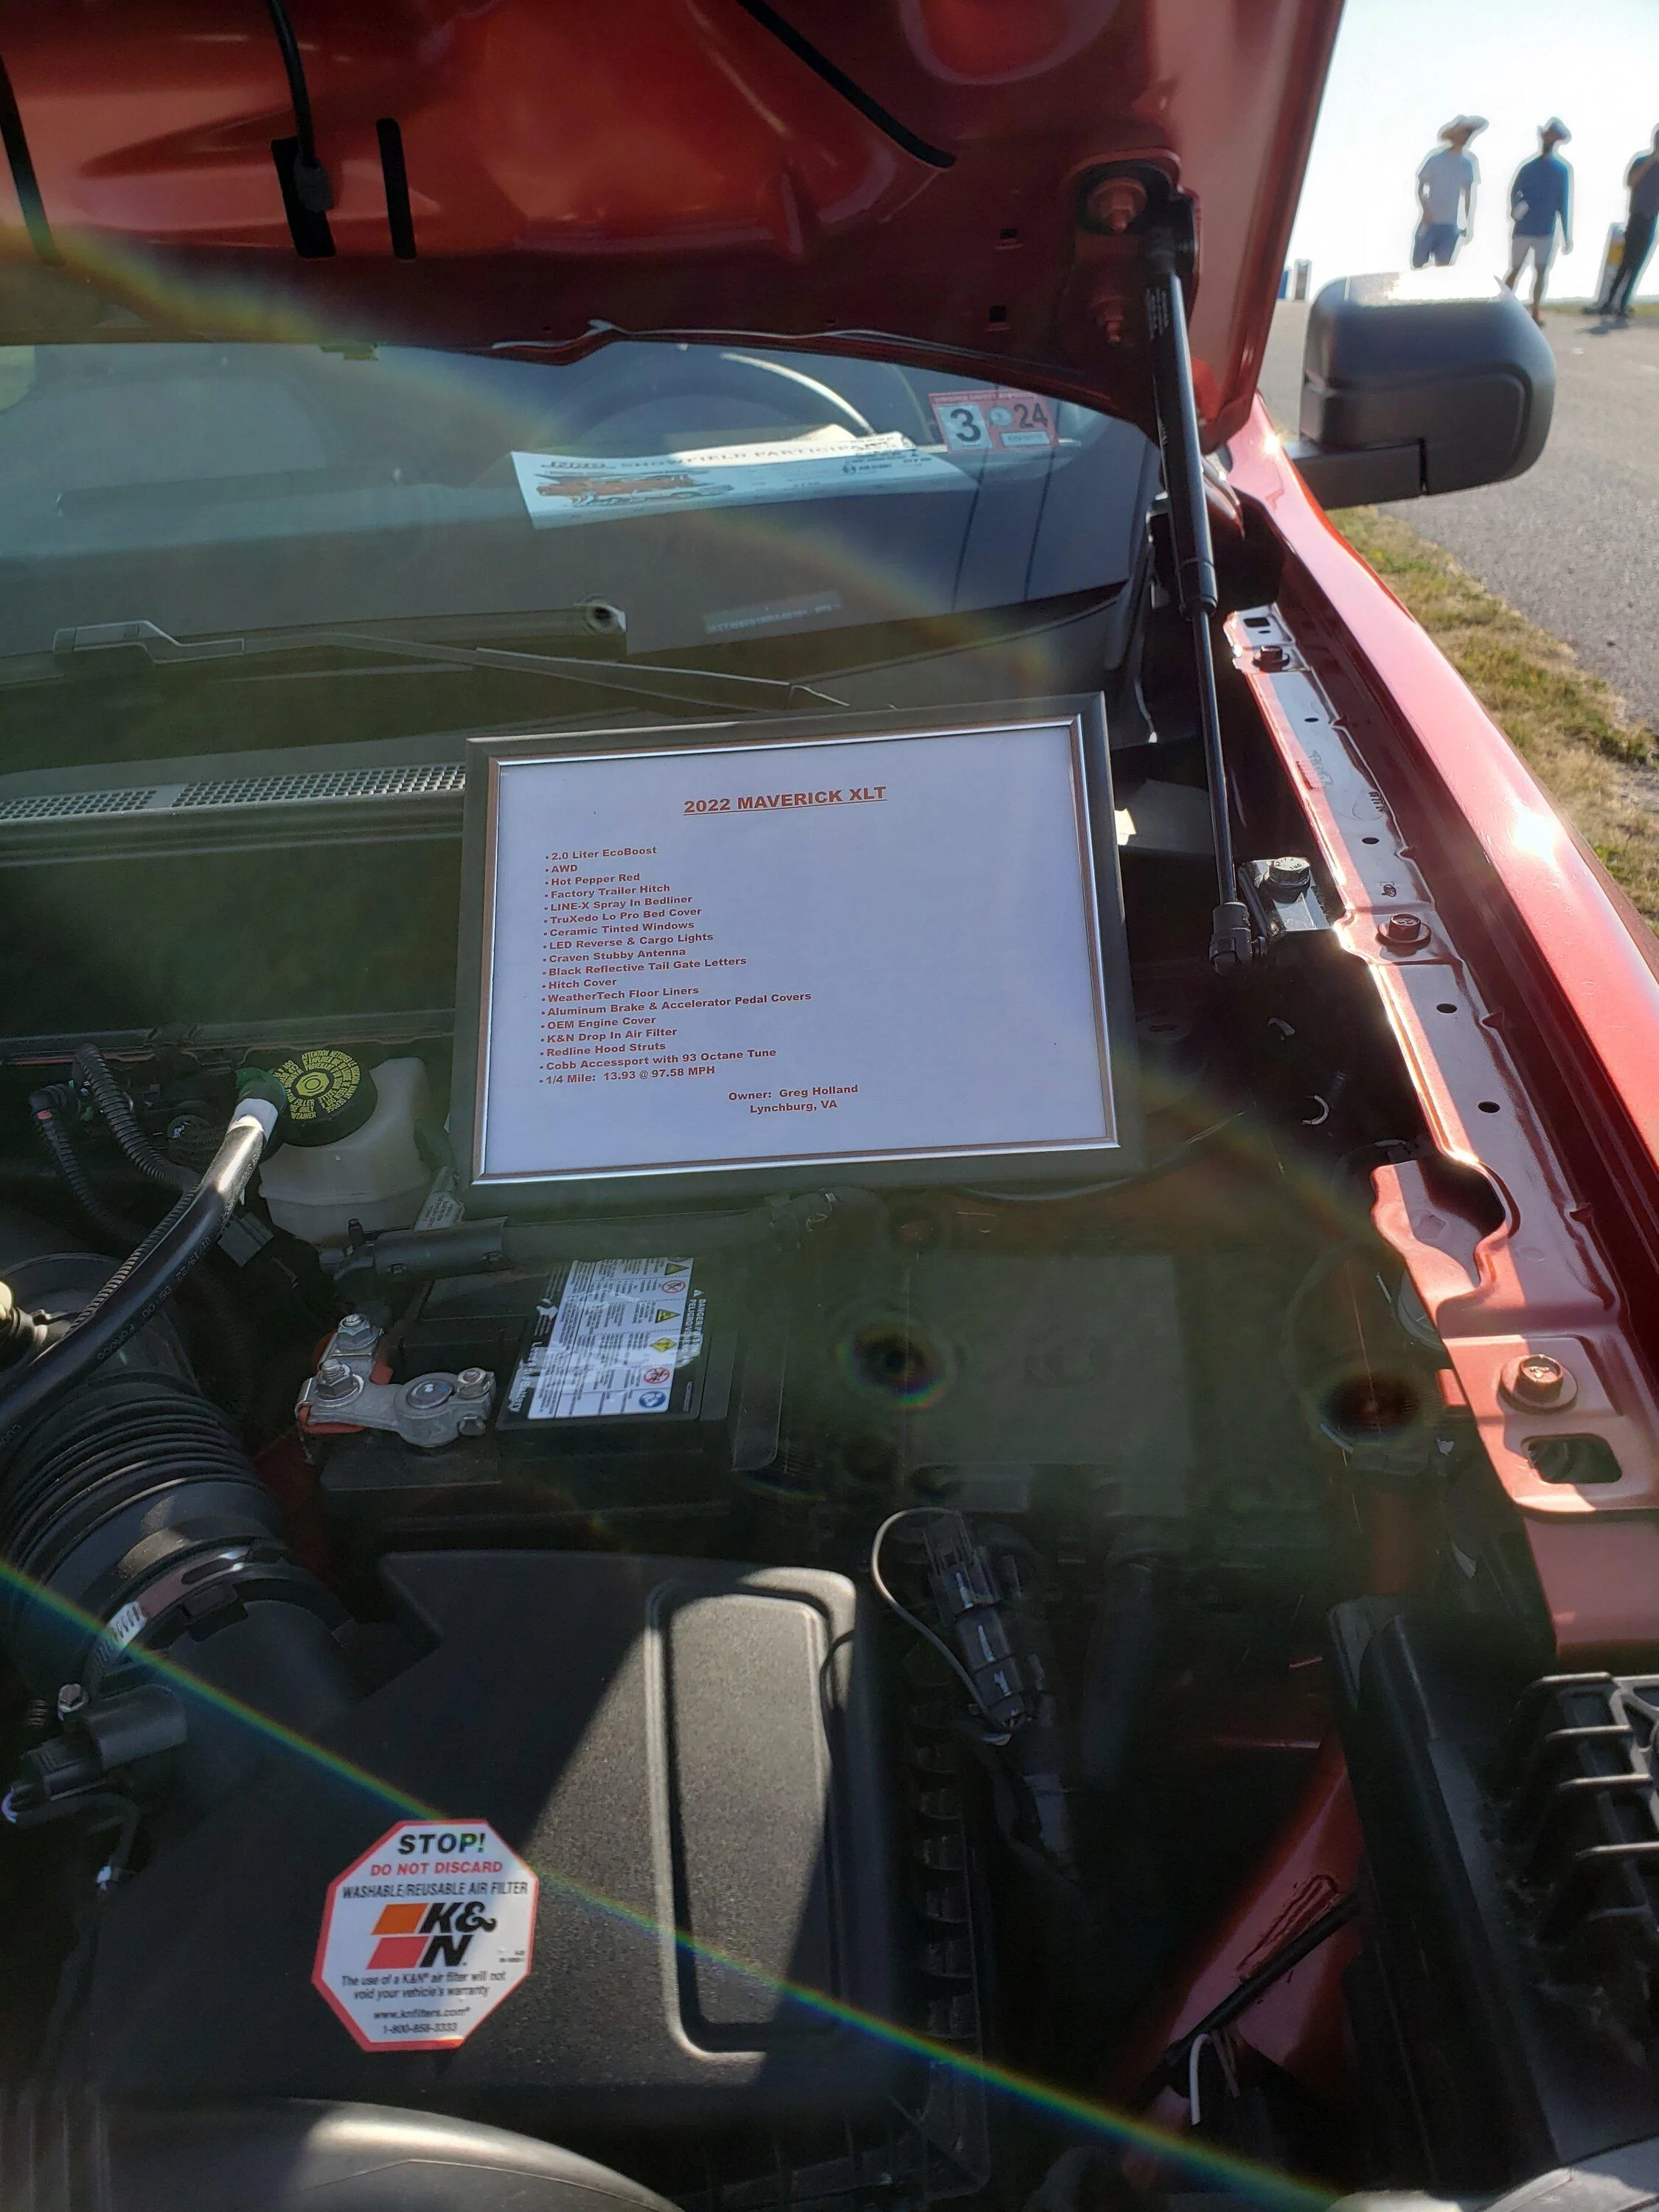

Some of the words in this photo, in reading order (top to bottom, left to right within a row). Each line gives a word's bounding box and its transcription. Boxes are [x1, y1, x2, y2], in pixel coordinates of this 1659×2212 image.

[1014, 403, 1048, 428] 24
[950, 408, 981, 442] 3
[684, 798, 731, 813] 2022
[737, 789, 844, 810] MAVERICK
[849, 786, 886, 801] XLT
[551, 852, 568, 860] 2.0
[572, 850, 600, 859] Liter
[602, 846, 658, 858] EcoBoost
[551, 864, 578, 874] AWD
[551, 877, 572, 886] Hot
[574, 876, 616, 886] Pepper
[618, 872, 640, 882] Red
[550, 889, 596, 899] Factory
[597, 886, 637, 896] Trailer
[639, 883, 670, 894] Hitch
[550, 901, 590, 912] LINE-X
[593, 900, 627, 911] Spray
[630, 898, 641, 907] In
[644, 896, 693, 906] Bedliner
[549, 914, 599, 925] TruXedo
[602, 913, 616, 921] Lo
[619, 911, 639, 920] Pro
[643, 909, 665, 919] Bed
[669, 908, 703, 917] Cover
[549, 926, 598, 936] Ceramic
[601, 923, 639, 933] Tinted
[641, 921, 695, 931] Windows
[549, 941, 572, 950] LED
[576, 939, 623, 948] Reverse
[626, 936, 636, 945] &
[639, 936, 674, 946] Cargo
[678, 933, 714, 944] Lights
[549, 954, 590, 963] Craven
[593, 950, 634, 961] Stubby
[636, 949, 686, 959] Antenna
[549, 966, 582, 976] Black
[585, 963, 645, 974] Reflective
[647, 961, 669, 971] Tail
[672, 960, 701, 969] Gate
[704, 958, 747, 967] Letters
[548, 979, 580, 990] Hitch
[583, 978, 617, 987] Cover
[547, 990, 625, 1003] WeatherTech
[629, 990, 660, 998] Floor
[662, 987, 700, 996] Liners
[546, 1006, 607, 1017] Aluminum
[611, 1003, 645, 1013] Brake
[649, 1001, 658, 1010] &
[661, 998, 732, 1010] Accelerator
[734, 994, 768, 1005] Pedal
[771, 993, 812, 1003] Covers
[547, 1020, 574, 1030] OEM
[578, 1018, 619, 1029] Engine
[622, 1017, 657, 1026] Cover
[546, 1033, 575, 1044] K&N
[578, 1033, 607, 1043] Drop
[610, 1031, 622, 1040] In
[625, 1029, 643, 1039] Air
[646, 1028, 678, 1037] Filter
[546, 1046, 591, 1057] Redline
[594, 1043, 626, 1054] Hood
[629, 1042, 667, 1051] Struts
[546, 1060, 577, 1071] Cobb
[580, 1056, 650, 1069] Accessport
[652, 1054, 679, 1064] with
[682, 1053, 697, 1062] 93
[700, 1051, 744, 1061] Octane
[746, 1049, 776, 1058] Tune
[546, 1074, 564, 1085] 1/4
[566, 1074, 596, 1083] Mile:
[603, 1071, 636, 1081] 13.93
[639, 1070, 649, 1080] @
[651, 1068, 684, 1078] 97.58
[688, 1065, 715, 1076] MPH
[728, 1091, 772, 1101] Owner:
[779, 1089, 809, 1099] Greg
[812, 1084, 858, 1096] Holland
[750, 1102, 817, 1116] Lynchburg,
[820, 1099, 838, 1109] VA
[397, 1833, 485, 1855] STOP!
[371, 1864, 392, 1877] DO
[397, 1863, 430, 1875] NOT
[434, 1861, 503, 1874] DISCARD
[468, 1882, 487, 1895] AIR
[490, 1882, 528, 1895] FILTER
[342, 1975, 358, 1986] The
[361, 1977, 378, 1986] use
[381, 1974, 392, 1985] of
[394, 1976, 400, 1985] a
[431, 1973, 444, 1983] air
[447, 1972, 468, 1982] filter
[471, 1970, 487, 1981] will
[490, 1971, 507, 1981] not
[354, 1989, 375, 2000] void
[376, 1990, 400, 2002] your
[403, 1987, 445, 1998] vehicle's
[448, 1986, 490, 1997] warranty
